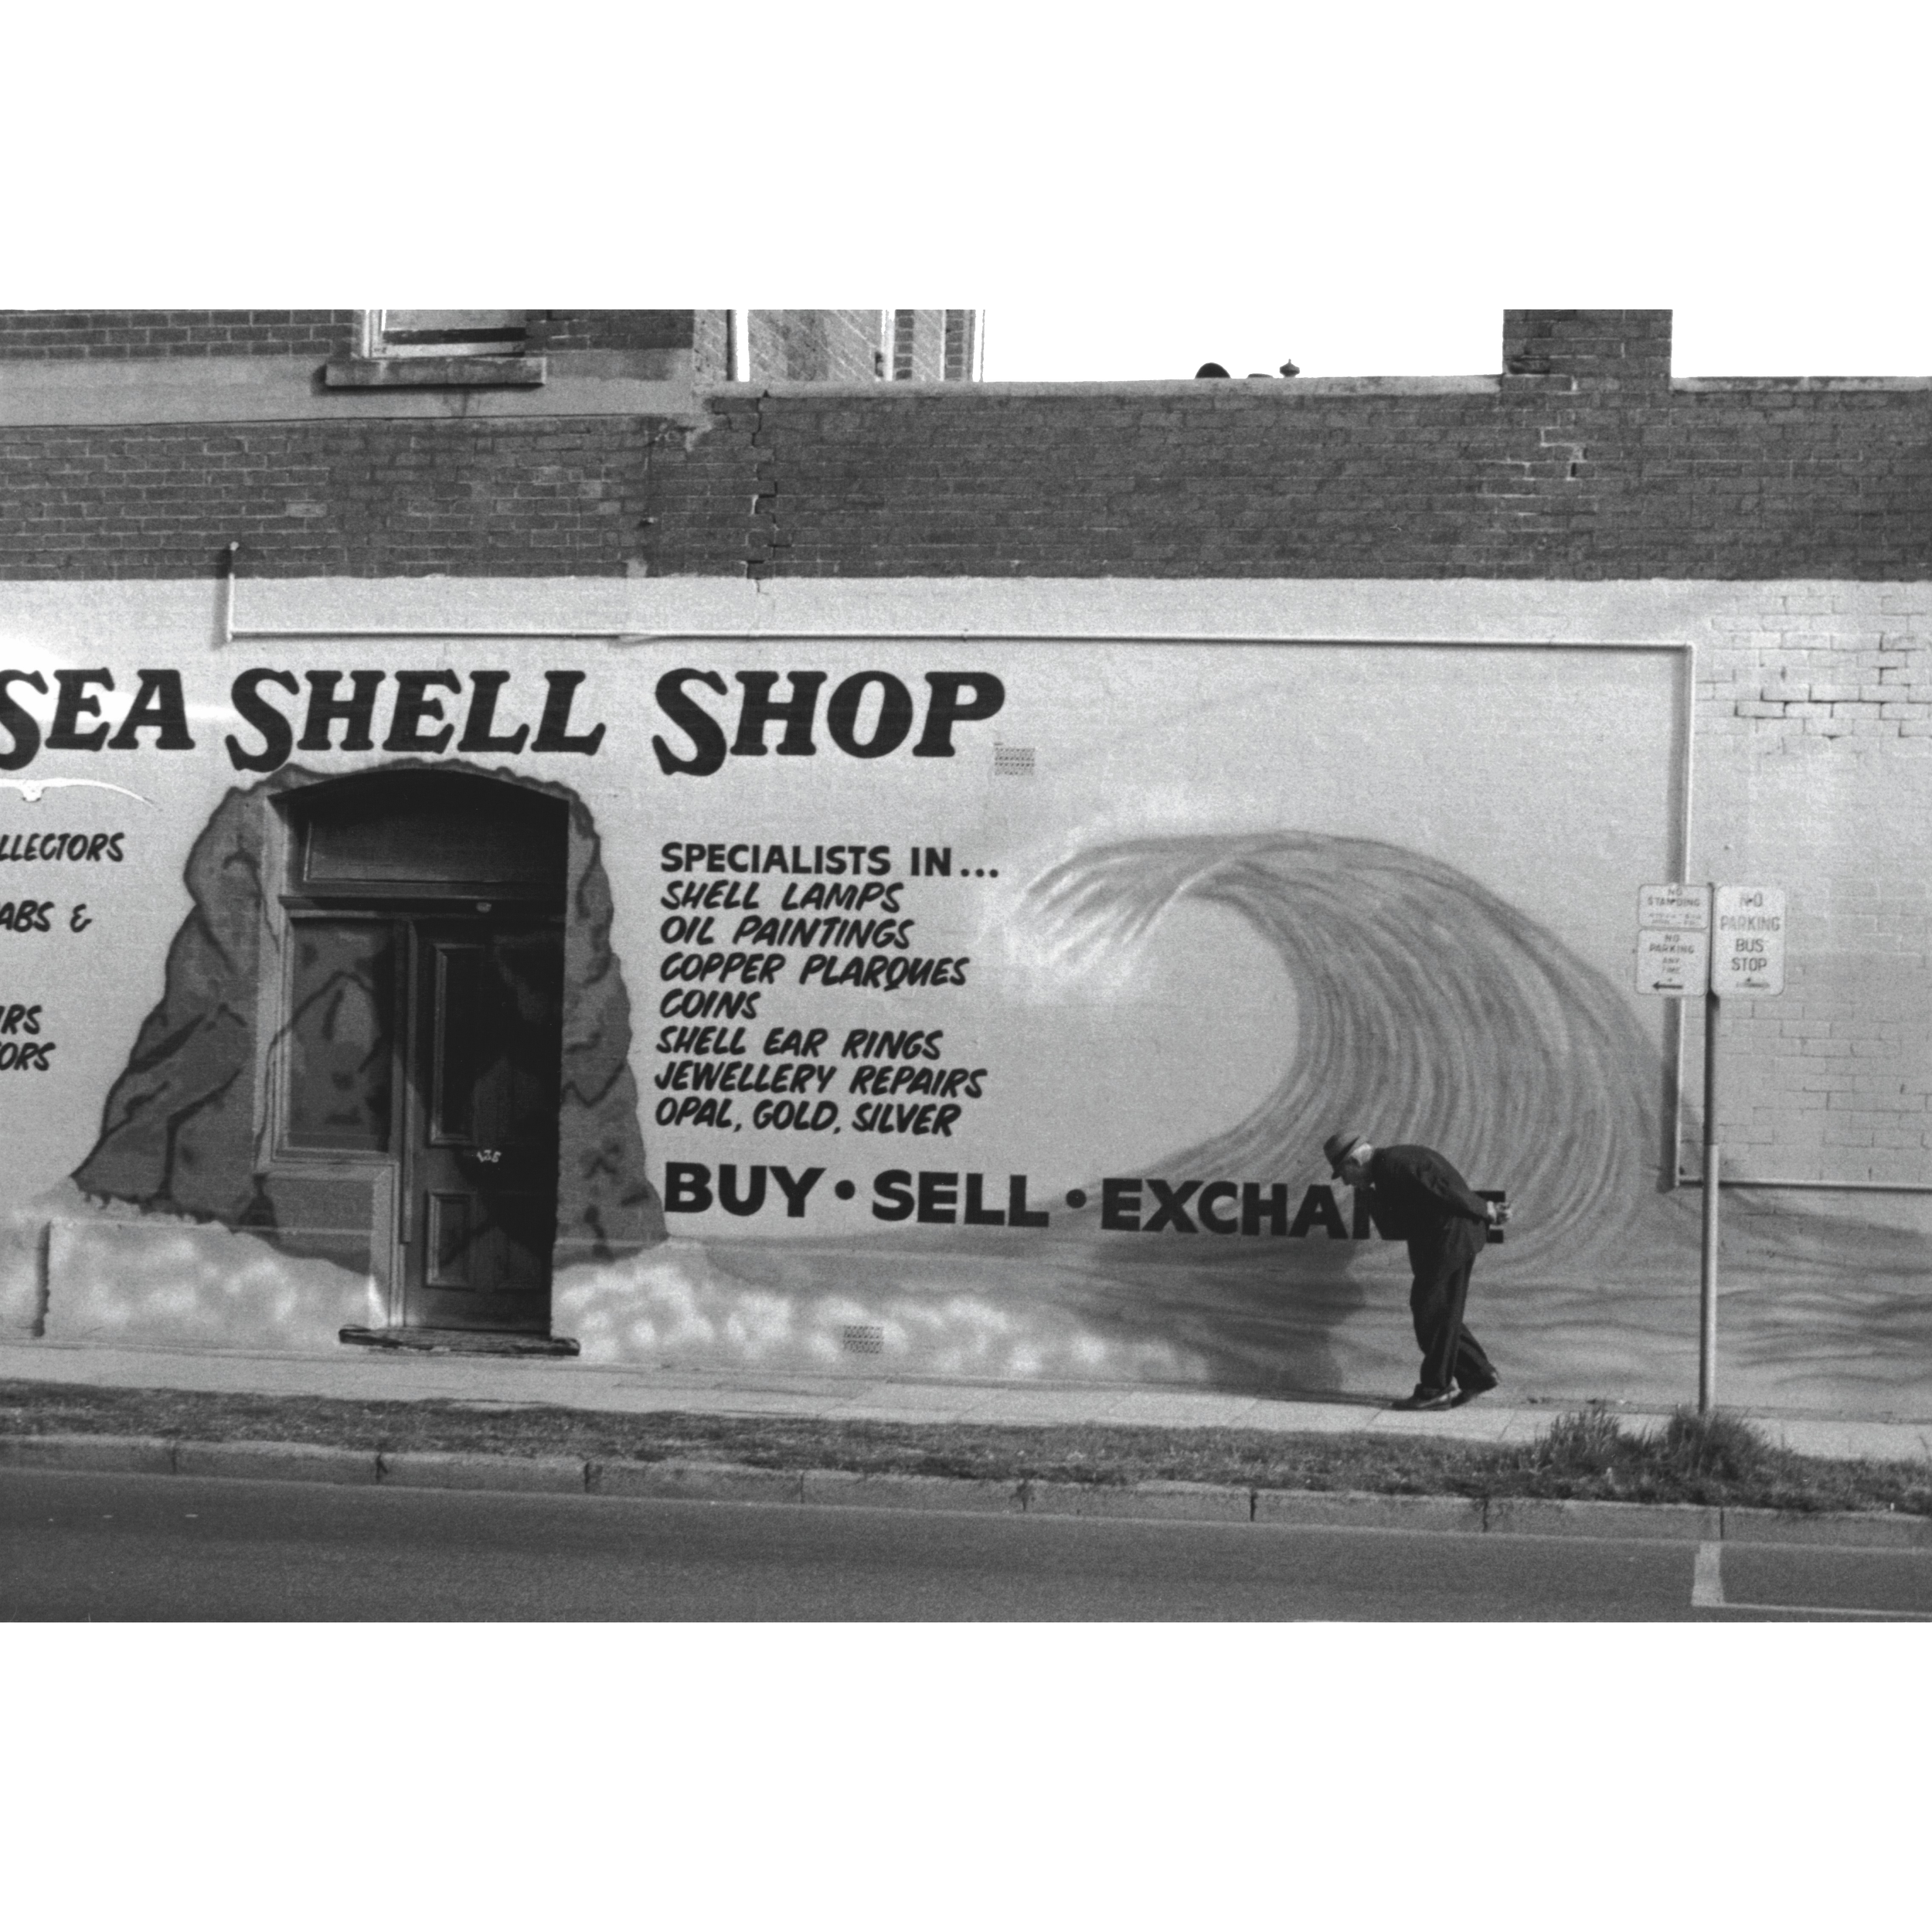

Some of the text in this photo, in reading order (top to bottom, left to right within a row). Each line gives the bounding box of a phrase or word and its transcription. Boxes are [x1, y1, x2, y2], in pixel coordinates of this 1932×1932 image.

[0, 668, 1005, 777] SEA SHELL SHOP
[661, 842, 891, 876] SPECIALISTS
[660, 879, 904, 913] SHELL LAMPS
[1739, 893, 1764, 907] NO
[70, 903, 92, 933] &
[660, 915, 915, 950] OIL PAINTINGS
[1720, 915, 1781, 931] PARKING
[1648, 944, 1694, 954] PARKING
[1664, 934, 1680, 942] NO
[1736, 938, 1764, 953] BUS
[660, 952, 970, 992] COPPER PLARQUES
[1731, 957, 1767, 971] STOP
[659, 988, 761, 1019] COINS
[655, 1026, 944, 1060] SHELL EAR RINGS
[655, 1060, 988, 1098] JEWELLERY REPAIRS
[655, 1096, 961, 1137] OPAL, GOLD, SILVER
[664, 1162, 827, 1218] BUY
[872, 1168, 1050, 1229] SELL
